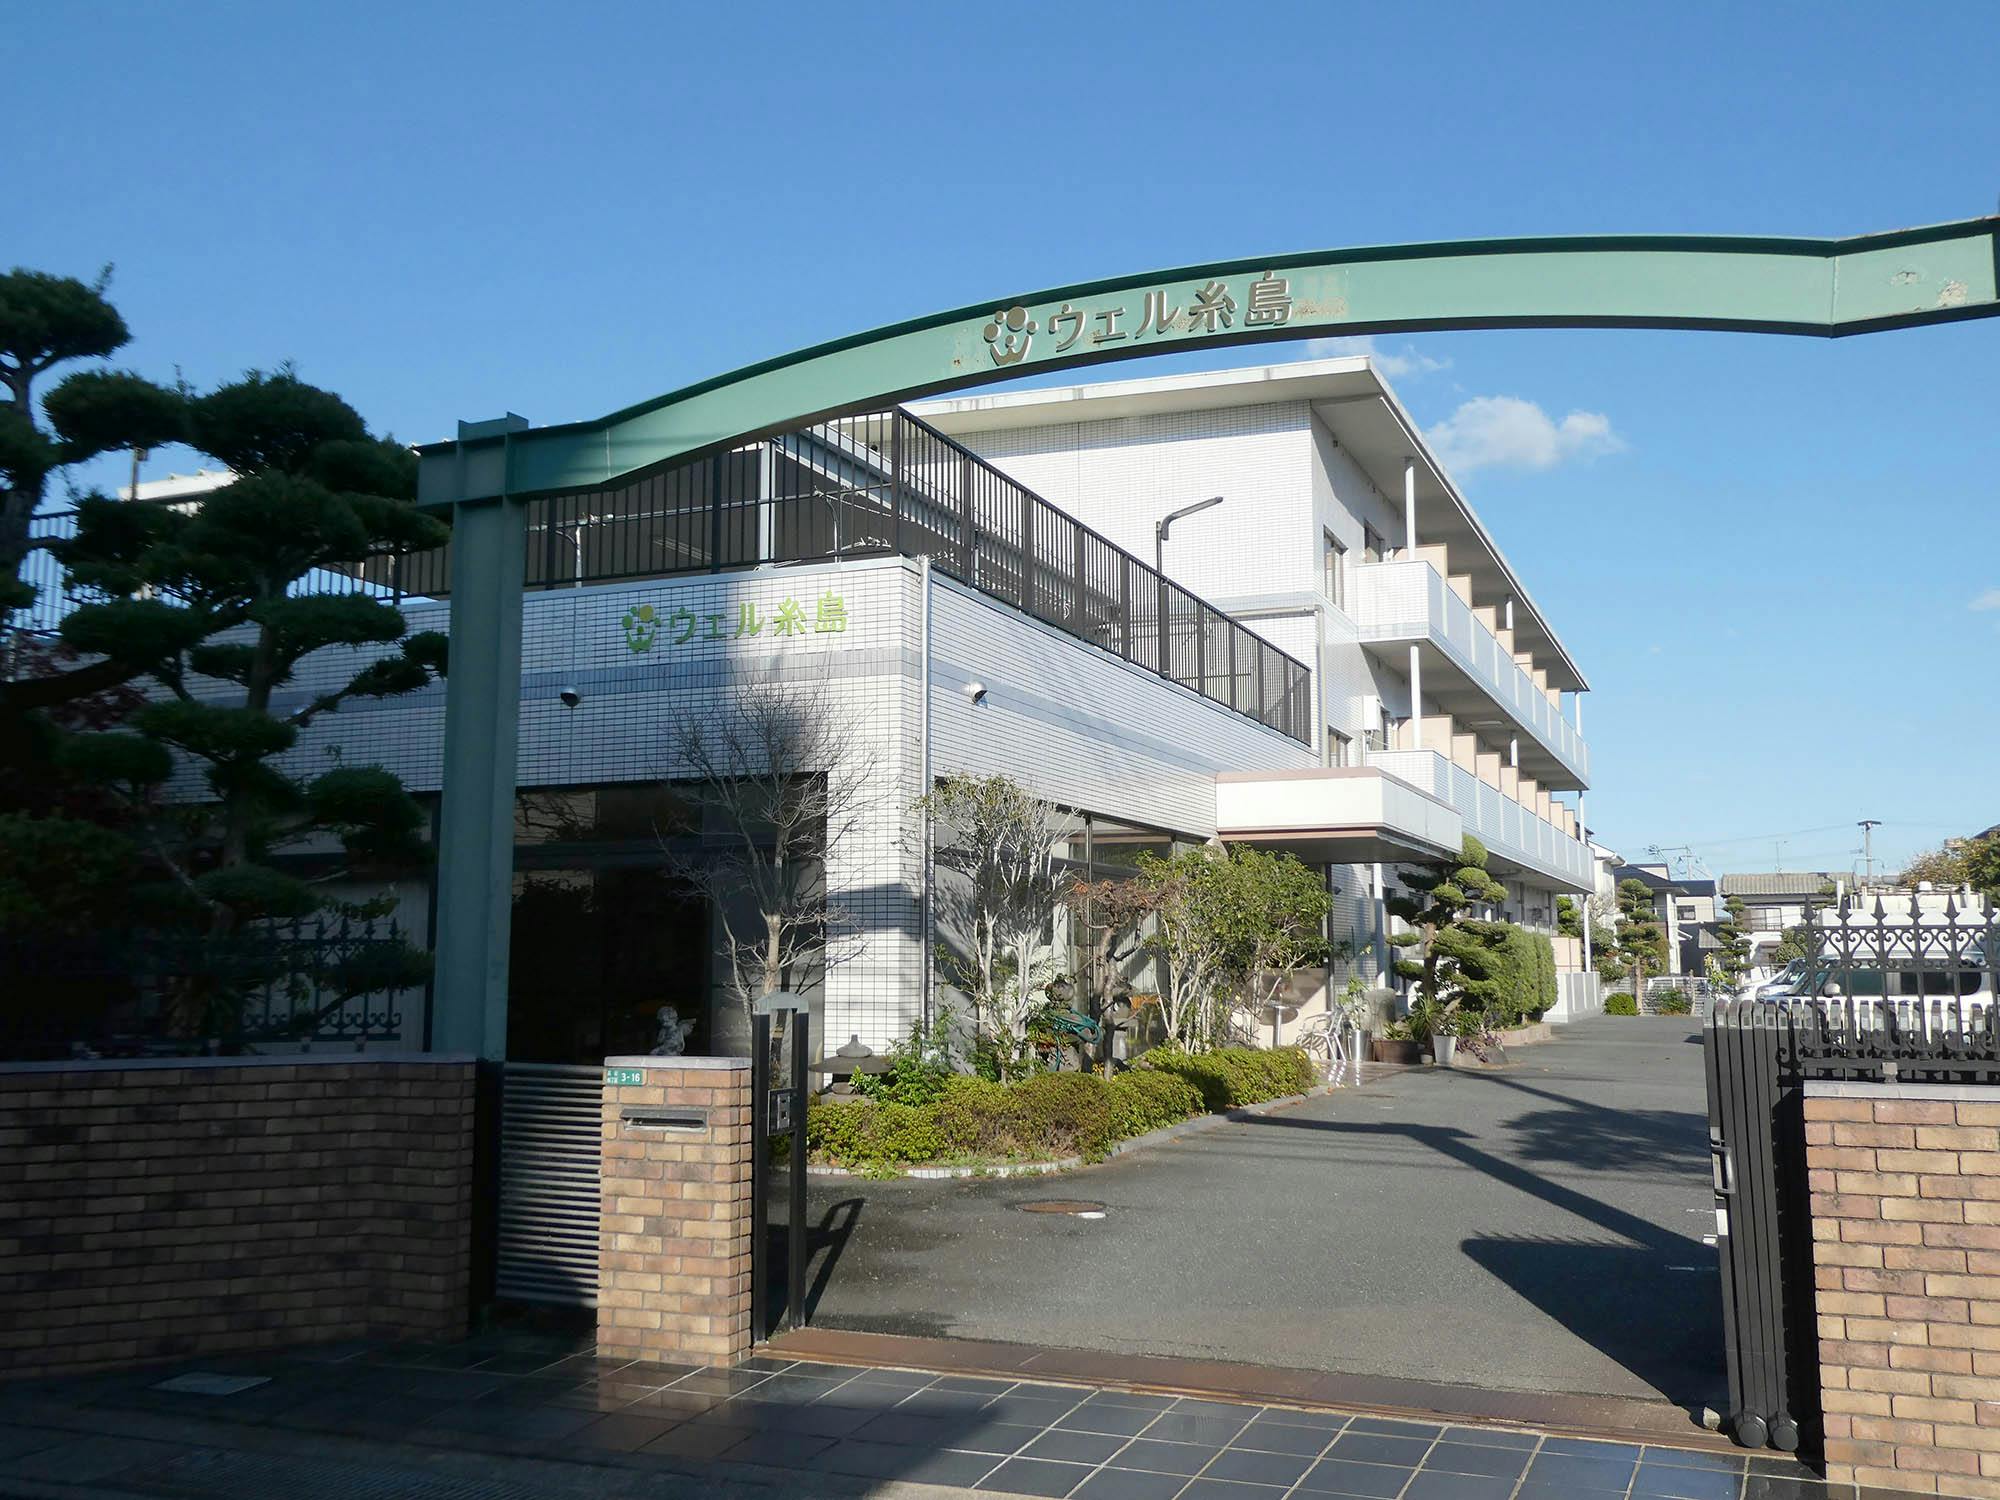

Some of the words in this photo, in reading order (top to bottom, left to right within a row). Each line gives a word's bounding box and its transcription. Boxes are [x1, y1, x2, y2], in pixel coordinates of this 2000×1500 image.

[1048, 270, 1293, 352] ウェル糸島
[670, 590, 848, 644] ウェル糸島
[621, 1072, 641, 1082] 3-16
